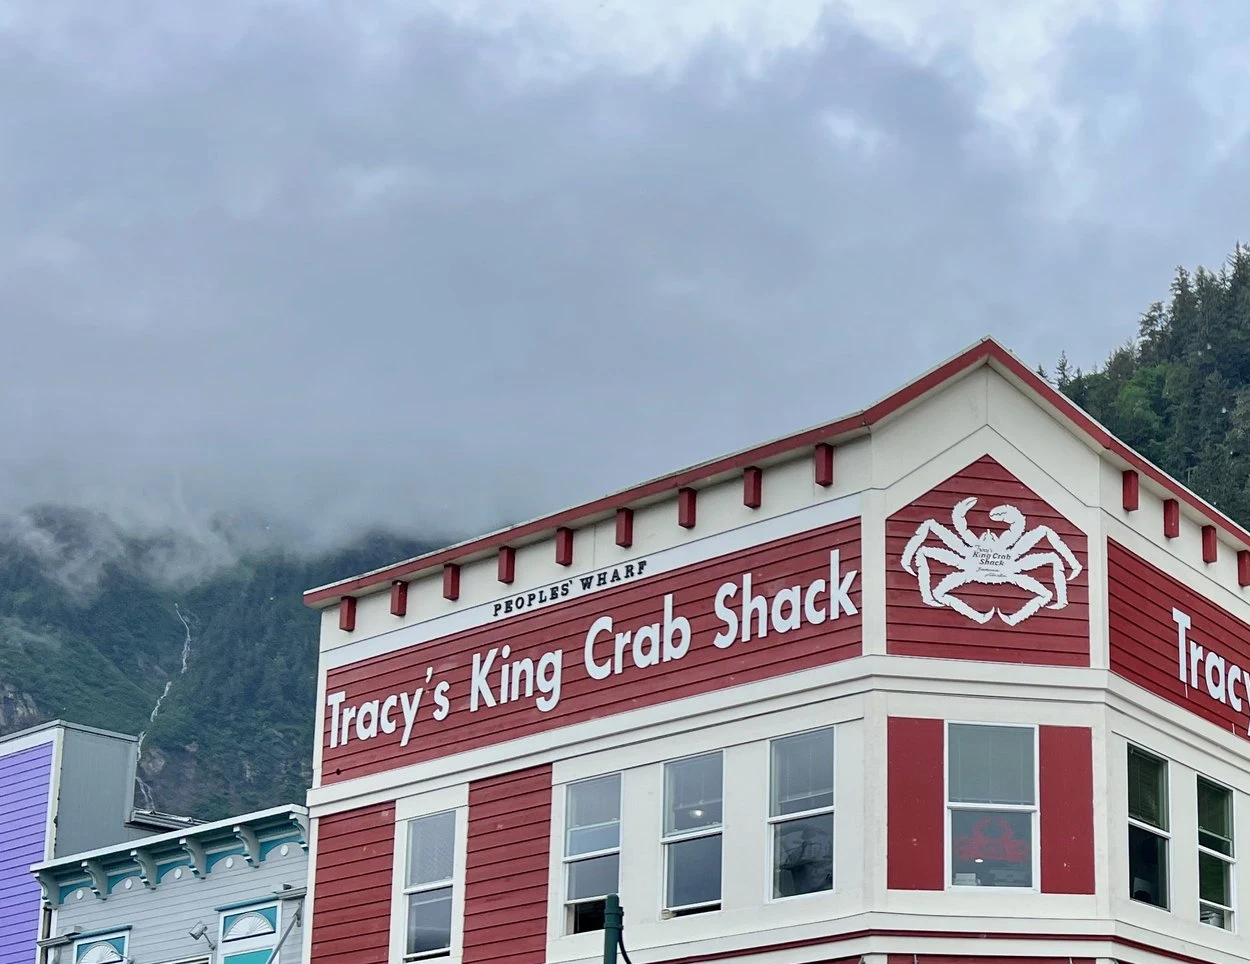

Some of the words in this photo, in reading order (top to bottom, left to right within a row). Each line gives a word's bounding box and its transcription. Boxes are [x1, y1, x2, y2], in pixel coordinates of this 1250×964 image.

[580, 560, 648, 592] WHARF
[979, 558, 1005, 566] Shack
[327, 666, 450, 747] Tracy's
[470, 644, 562, 713] King
[583, 594, 692, 681] Crab
[713, 549, 859, 649] Shack
